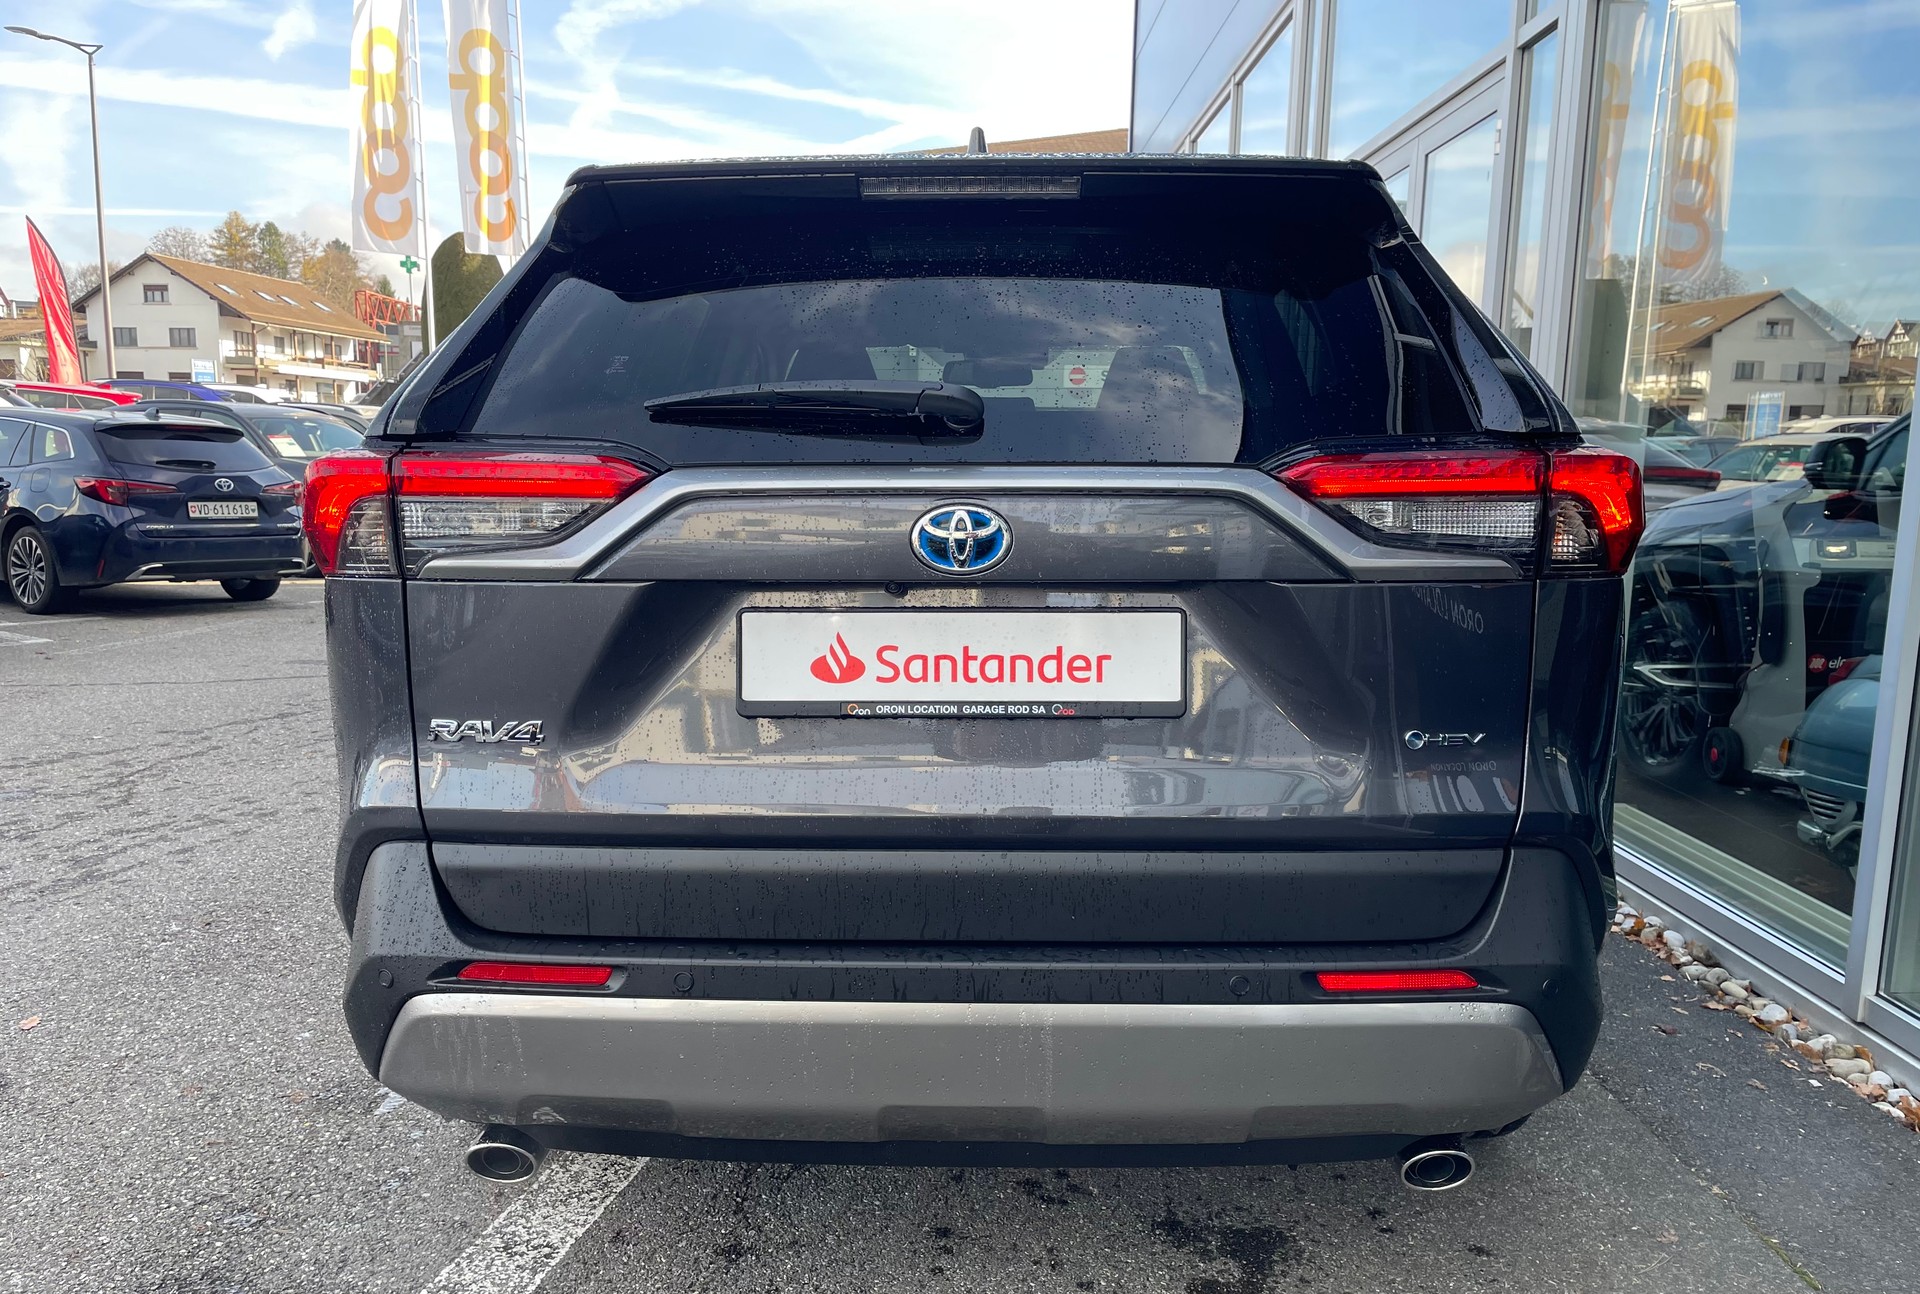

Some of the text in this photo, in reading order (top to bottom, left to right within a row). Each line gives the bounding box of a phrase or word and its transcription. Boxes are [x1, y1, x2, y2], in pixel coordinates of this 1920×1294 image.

[875, 645, 1112, 684] Santander
[875, 704, 905, 714] ORON
[907, 704, 958, 714] LOCATION
[962, 705, 1005, 714] GARAGE
[1007, 705, 1030, 714] ROD
[1031, 705, 1046, 714] SA
[427, 719, 545, 745] RAV4
